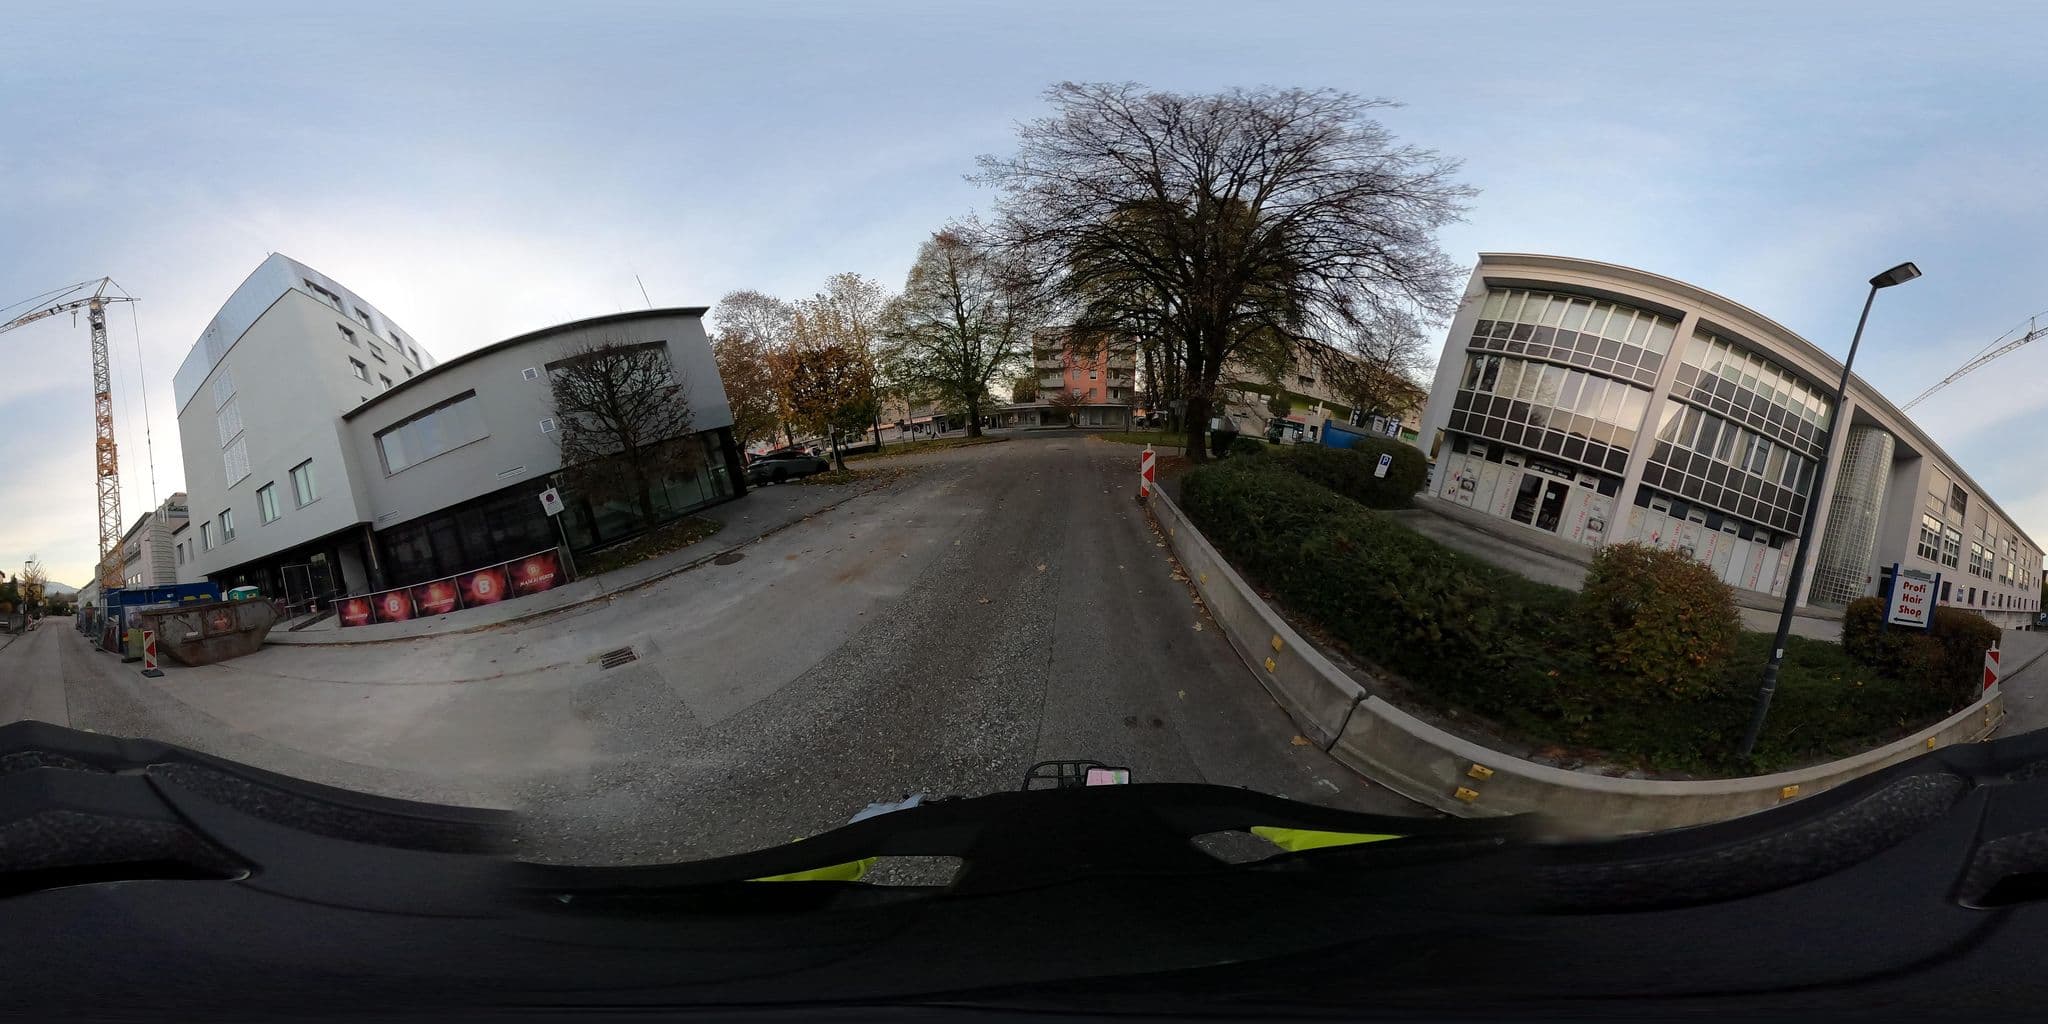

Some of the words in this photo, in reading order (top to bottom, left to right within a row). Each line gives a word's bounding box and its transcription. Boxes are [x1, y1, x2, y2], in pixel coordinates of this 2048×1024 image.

[1381, 456, 1389, 465] P
[1903, 581, 1927, 593] Profi
[1902, 593, 1923, 605] Hair
[1898, 605, 1922, 618] Shop
